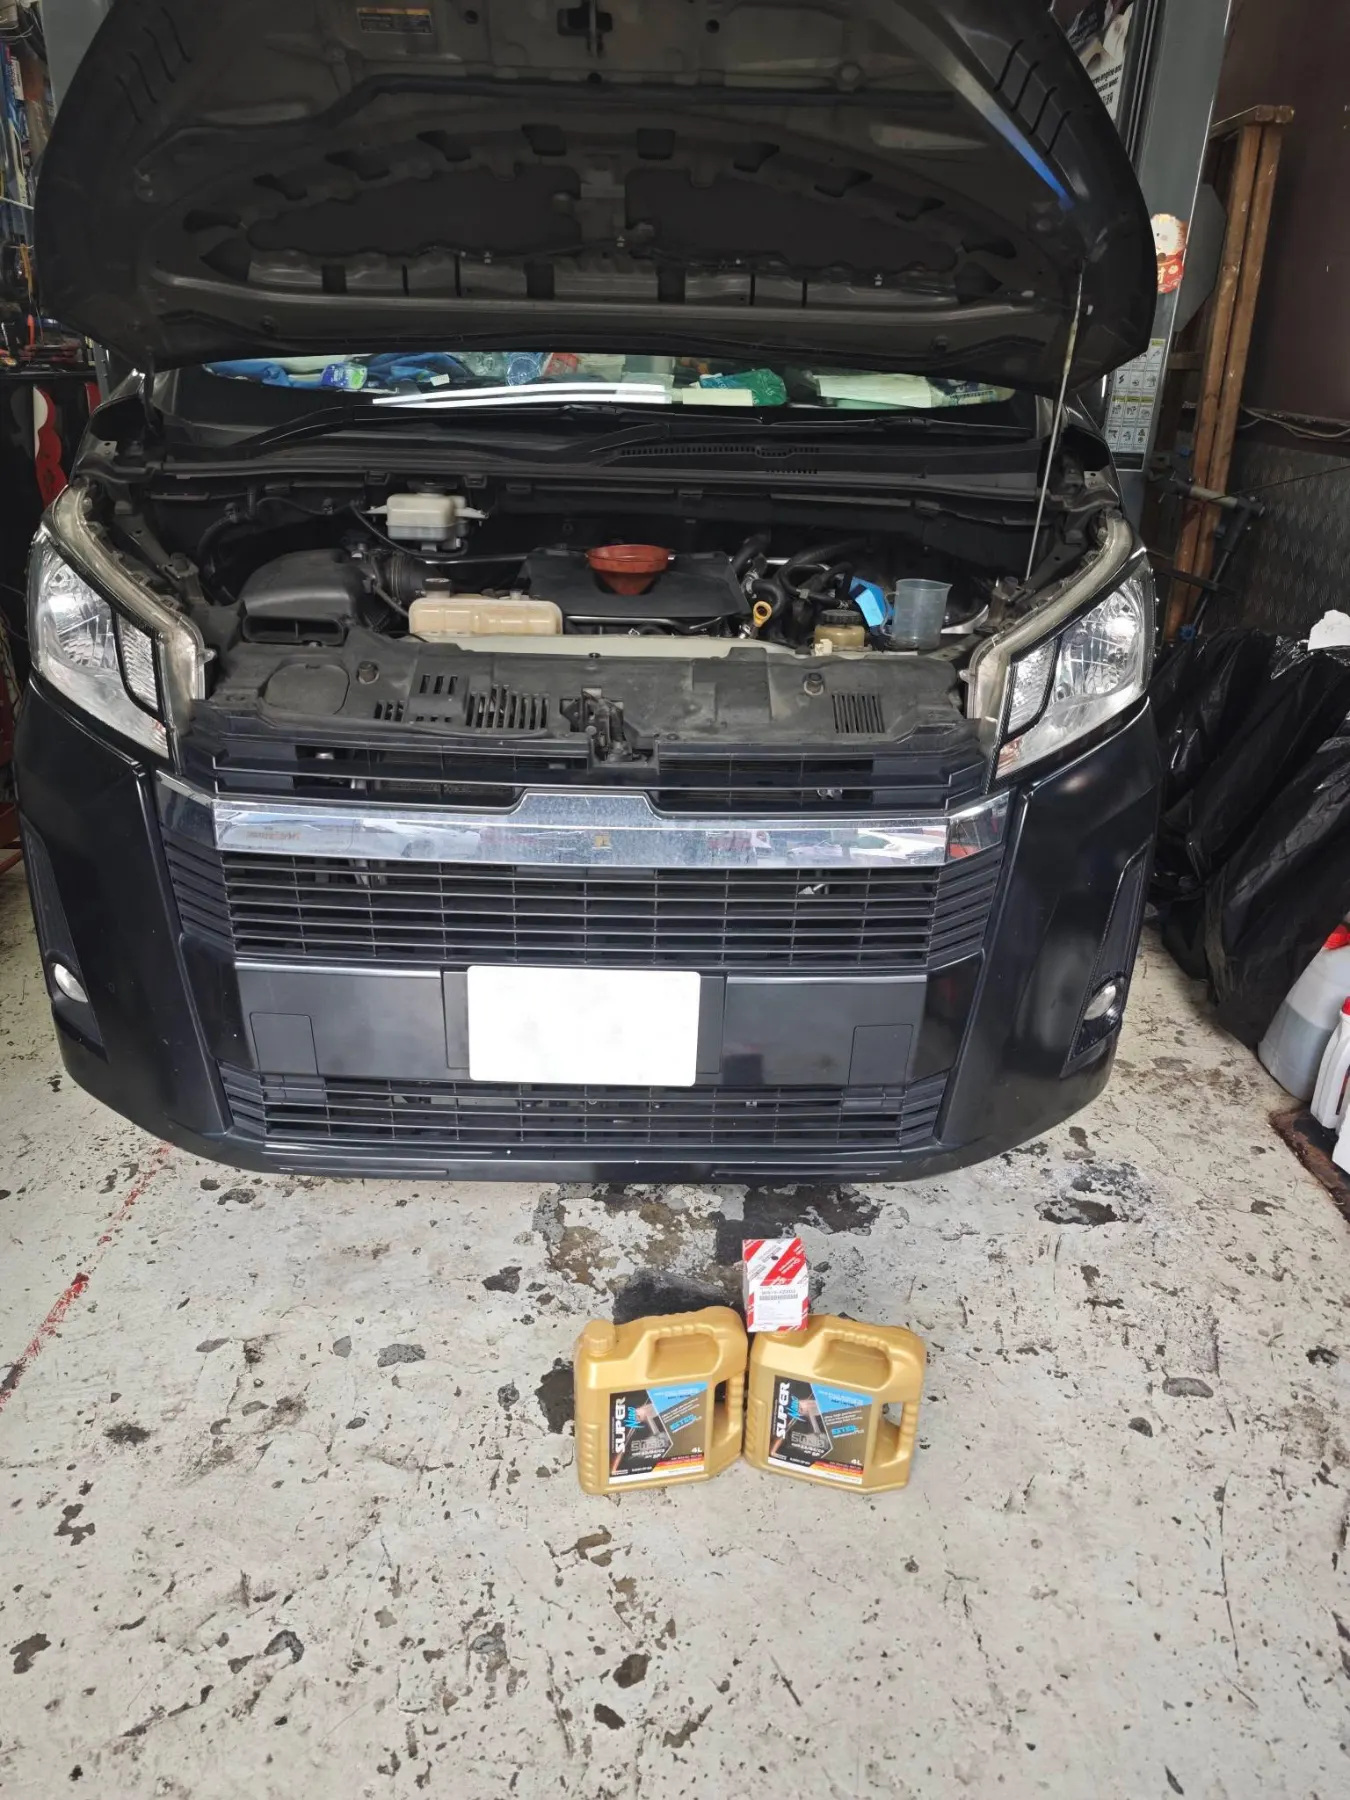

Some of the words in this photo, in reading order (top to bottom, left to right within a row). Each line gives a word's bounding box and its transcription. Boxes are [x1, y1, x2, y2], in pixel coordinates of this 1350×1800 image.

[623, 1406, 645, 1428] Nano
[776, 1382, 791, 1439] SUPER
[785, 1395, 806, 1422] Nano
[615, 1397, 626, 1453] SUPER
[850, 1458, 863, 1466] 4L
